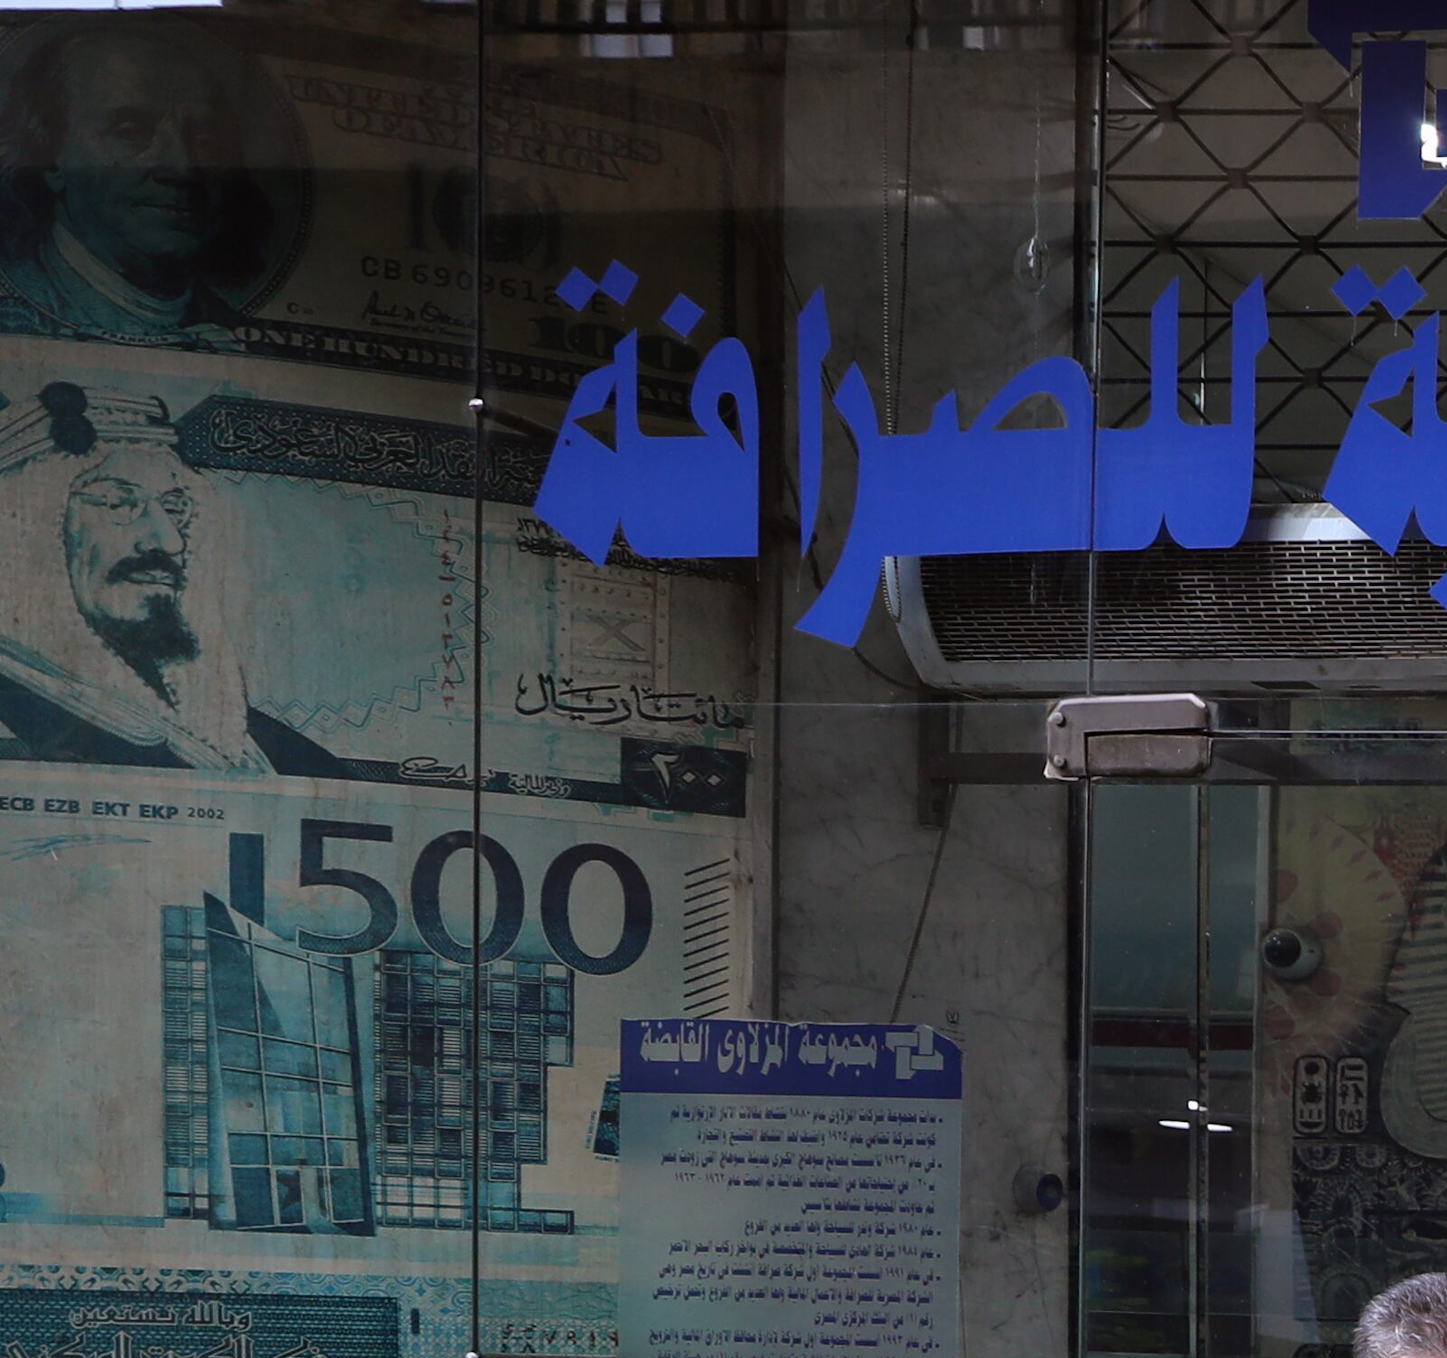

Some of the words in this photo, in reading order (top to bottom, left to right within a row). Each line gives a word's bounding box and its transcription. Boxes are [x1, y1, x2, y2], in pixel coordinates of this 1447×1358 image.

[361, 256, 402, 282] CB
[411, 264, 570, 301] 6909612
[533, 259, 1270, 648] للصرافة
[650, 751, 727, 799] ٢٠٠
[44, 799, 80, 814] EZB
[92, 801, 130, 817] EKT
[139, 804, 179, 820] EKP
[188, 807, 225, 820] 2002
[295, 818, 653, 976] 500
[798, 1026, 877, 1077] مجموعة
